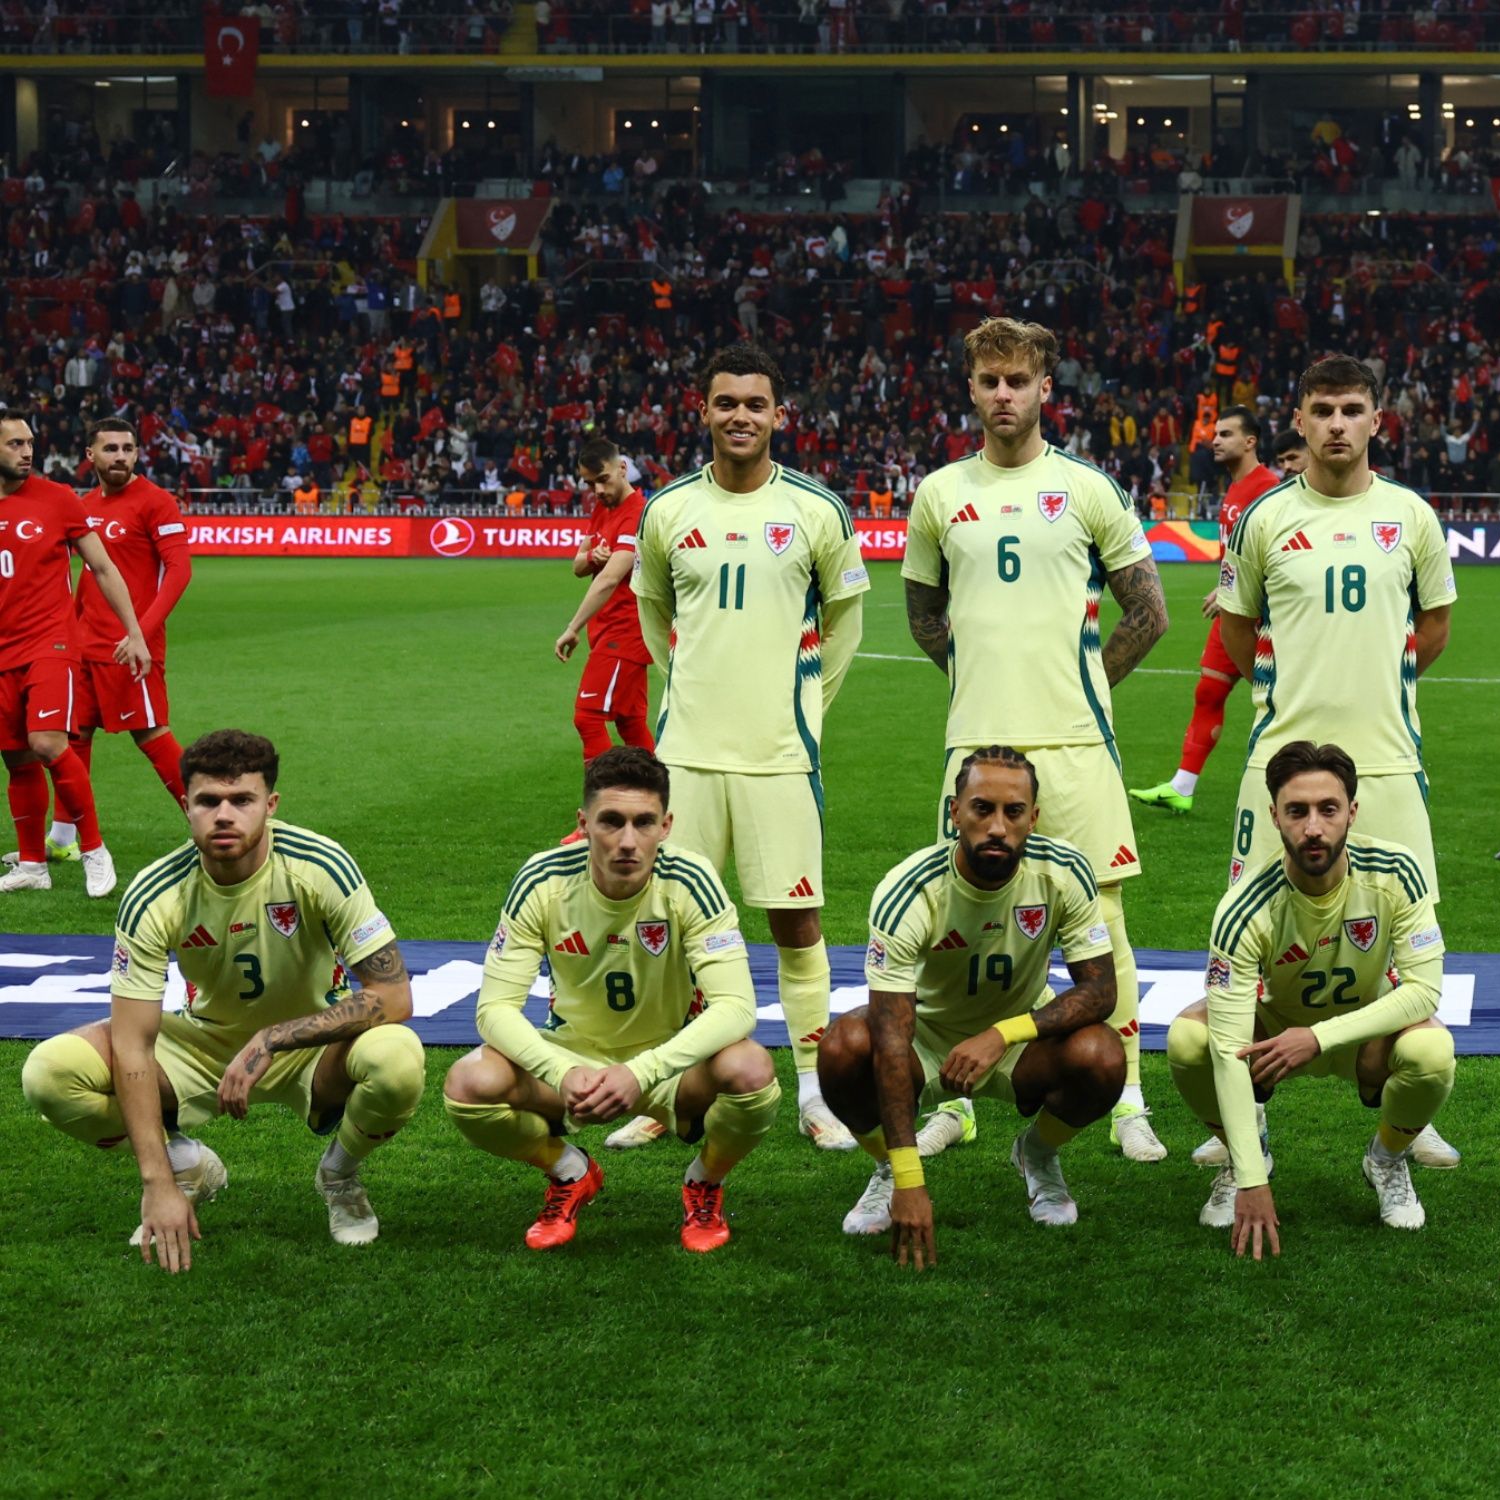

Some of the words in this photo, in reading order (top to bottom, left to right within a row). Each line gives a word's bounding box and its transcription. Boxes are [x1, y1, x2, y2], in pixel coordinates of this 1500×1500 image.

[187, 526, 274, 545] URKISH
[280, 527, 392, 546] AIRLINES
[997, 536, 1021, 583] 6
[719, 563, 745, 610] 11
[1325, 565, 1366, 613] 18
[233, 954, 265, 1000] 3
[604, 971, 637, 1013] 8
[967, 953, 1013, 996] 19
[1301, 966, 1360, 1009] 22
